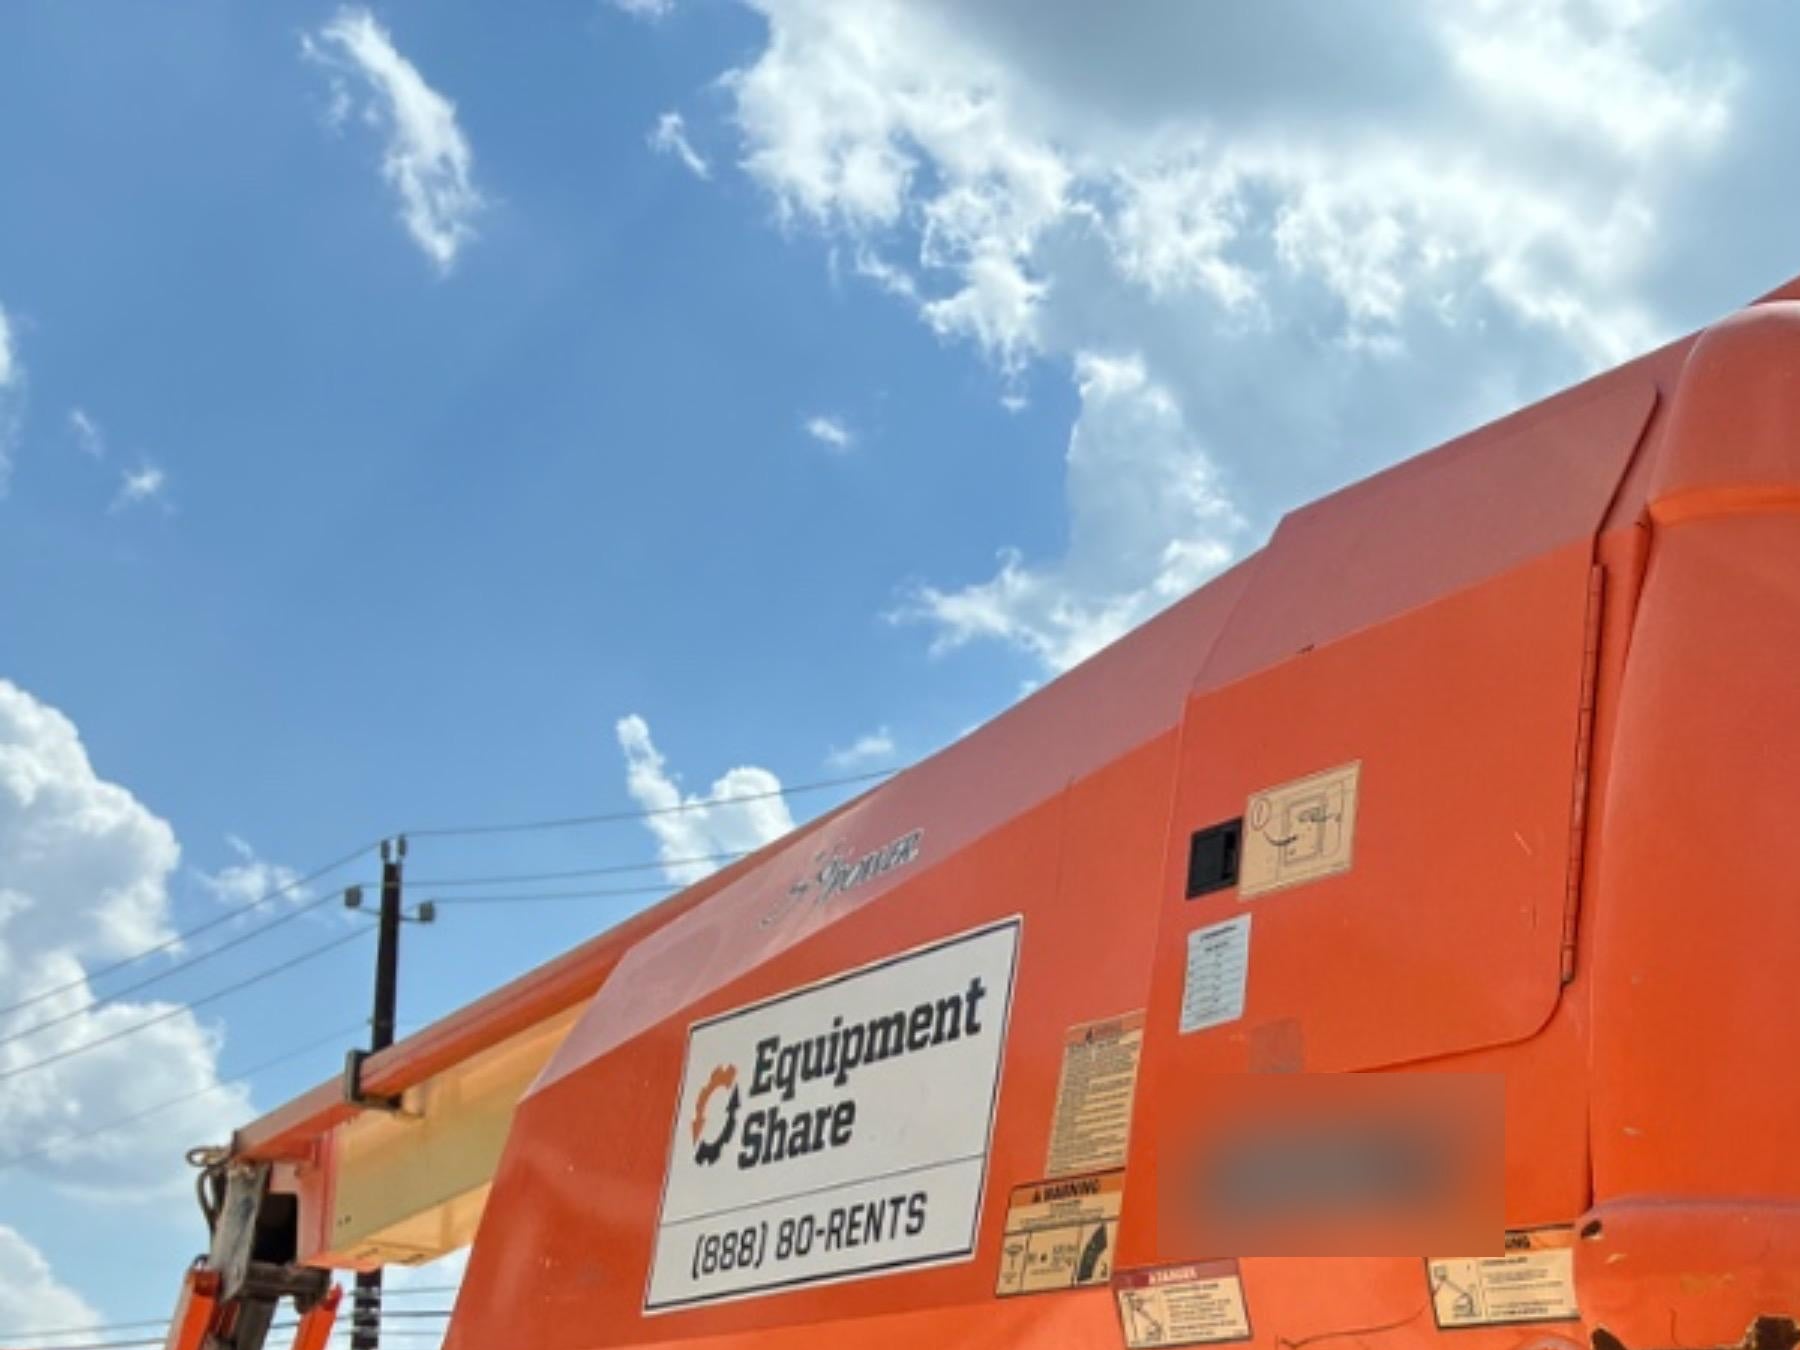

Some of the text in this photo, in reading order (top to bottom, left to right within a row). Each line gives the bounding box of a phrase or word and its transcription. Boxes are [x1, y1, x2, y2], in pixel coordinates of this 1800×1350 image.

[749, 977, 986, 1100] Equipment
[737, 1099, 856, 1170] Share
[691, 1191, 928, 1280] (888) 80-RENTS
